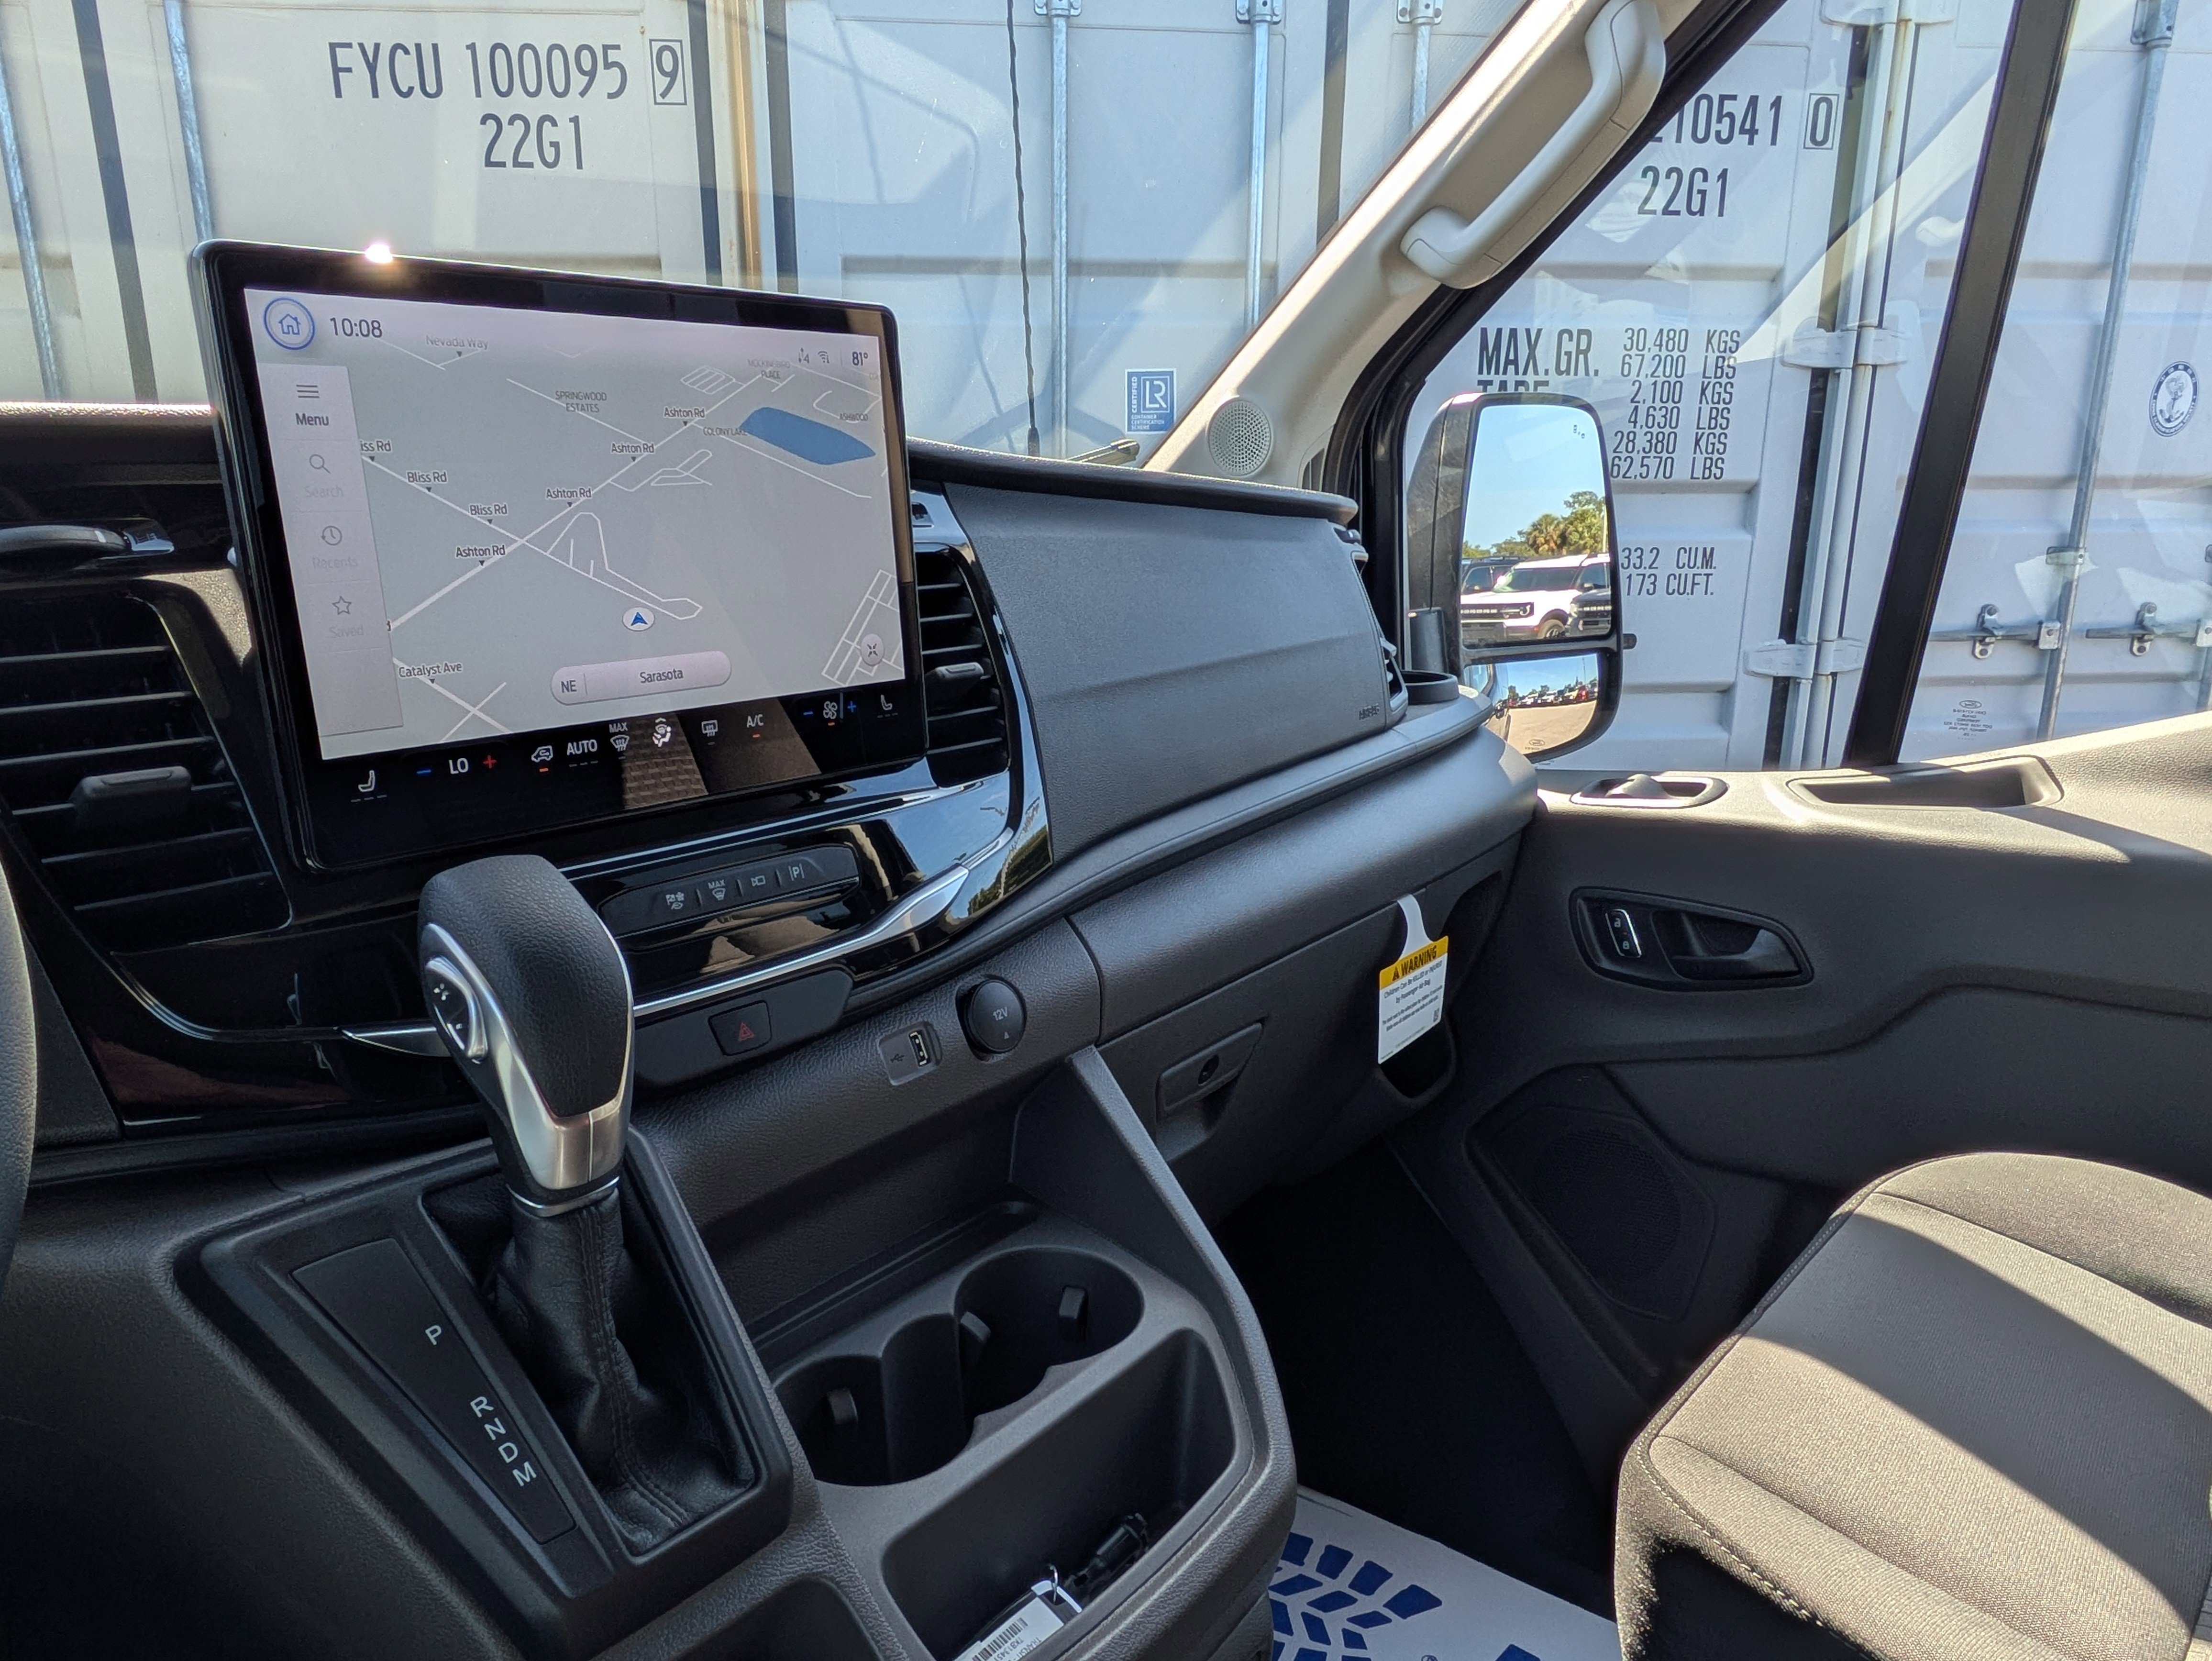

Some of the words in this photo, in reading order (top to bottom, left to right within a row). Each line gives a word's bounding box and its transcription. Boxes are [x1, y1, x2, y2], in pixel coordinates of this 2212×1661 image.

[329, 42, 443, 99] FYCU
[465, 42, 628, 99] 100095
[655, 44, 679, 99] 9
[1649, 94, 1782, 146] 10541
[1809, 97, 1833, 146] 0
[479, 113, 583, 169] 22G1
[1638, 166, 1728, 217] 22G1
[330, 317, 383, 338] 10:08
[467, 337, 488, 350] Way
[1478, 328, 1599, 376] MAX.GR.
[1623, 328, 1689, 353] 30,480
[1705, 330, 1740, 353] KGS
[1621, 354, 1685, 378] 67,200
[1702, 355, 1736, 379] LBS
[555, 390, 607, 401] SPRINGWOOD
[1631, 380, 1682, 404] 2,100
[1699, 382, 1734, 405] KGS
[566, 403, 599, 413] ESTATES
[664, 407, 693, 418] Ashton
[694, 408, 705, 418] Rd
[1628, 405, 1680, 430] 4,630
[1696, 407, 1730, 430] LBS
[296, 413, 329, 426] Menu
[376, 440, 391, 452] Rd
[611, 443, 641, 453] Ashton
[643, 443, 654, 454] Rd
[1613, 431, 1677, 455] 28,380
[1693, 432, 1727, 455] KGS
[407, 471, 431, 483] Bliss
[432, 471, 447, 482] Rd
[1611, 456, 1674, 479] 62,570
[1690, 457, 1725, 479] LBS
[546, 488, 578, 498] Ashton
[579, 487, 592, 498] Rd
[469, 505, 491, 515] Bliss
[493, 504, 508, 515] Rd
[455, 546, 490, 557] Ashton
[492, 545, 505, 556] Rd
[1621, 547, 1660, 570] 33.2
[1676, 547, 1716, 569] CU.M.
[1626, 573, 1657, 595] 173
[1666, 573, 1714, 595] CU.FT.
[398, 664, 441, 678] Catalyst
[444, 662, 463, 674] Ave
[561, 680, 577, 693] NE
[639, 668, 684, 684] Sarasota
[449, 758, 469, 775] LO
[566, 739, 597, 756] AUTO
[609, 722, 628, 733] MAX
[747, 714, 763, 728] A/C
[1401, 945, 1437, 976] WARNING
[993, 1007, 1007, 1020] 12V
[425, 1325, 442, 1345] P
[470, 1396, 494, 1417] R
[484, 1417, 506, 1440] N
[498, 1442, 519, 1463] D
[512, 1462, 537, 1486] M
